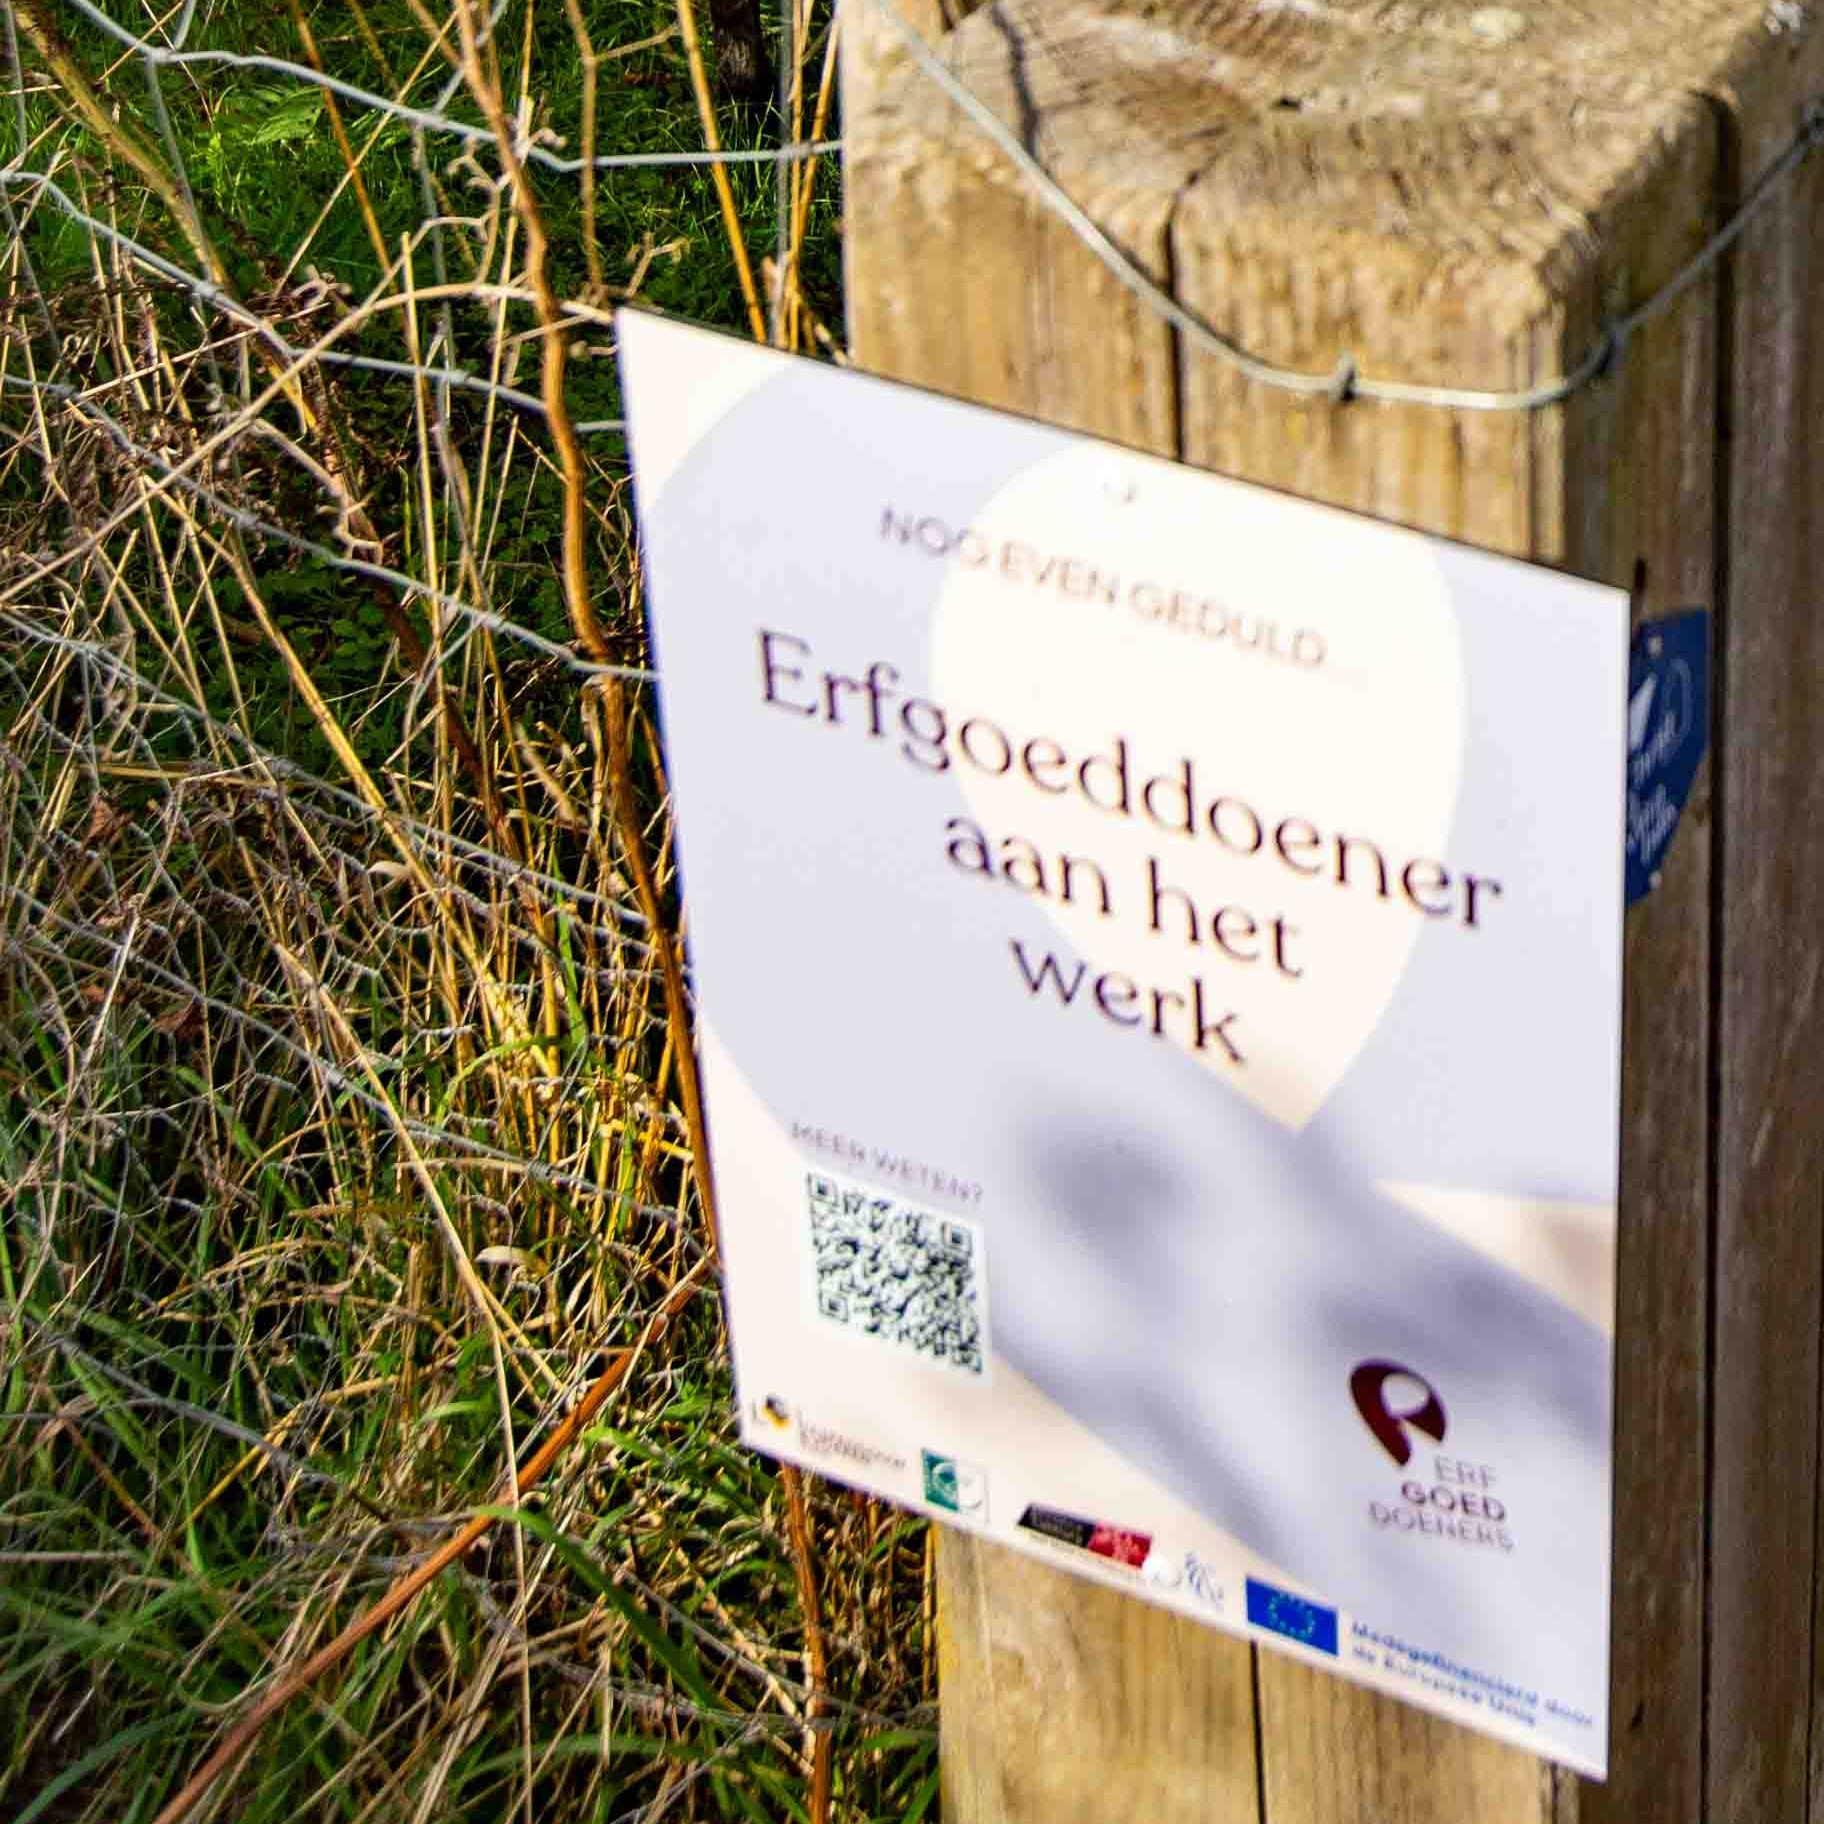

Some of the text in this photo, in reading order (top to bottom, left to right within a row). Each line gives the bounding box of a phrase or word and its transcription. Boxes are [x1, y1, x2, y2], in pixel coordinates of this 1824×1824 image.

[880, 506, 992, 570] NOG
[999, 540, 1118, 604] EVEN
[756, 627, 1502, 930] Erfgoeddoener
[945, 812, 1306, 980] aan het
[1008, 937, 1250, 1067] werk
[1401, 1479, 1506, 1522] GOED
[1435, 1455, 1496, 1489] ERF
[1368, 1500, 1515, 1552] DOENERS
